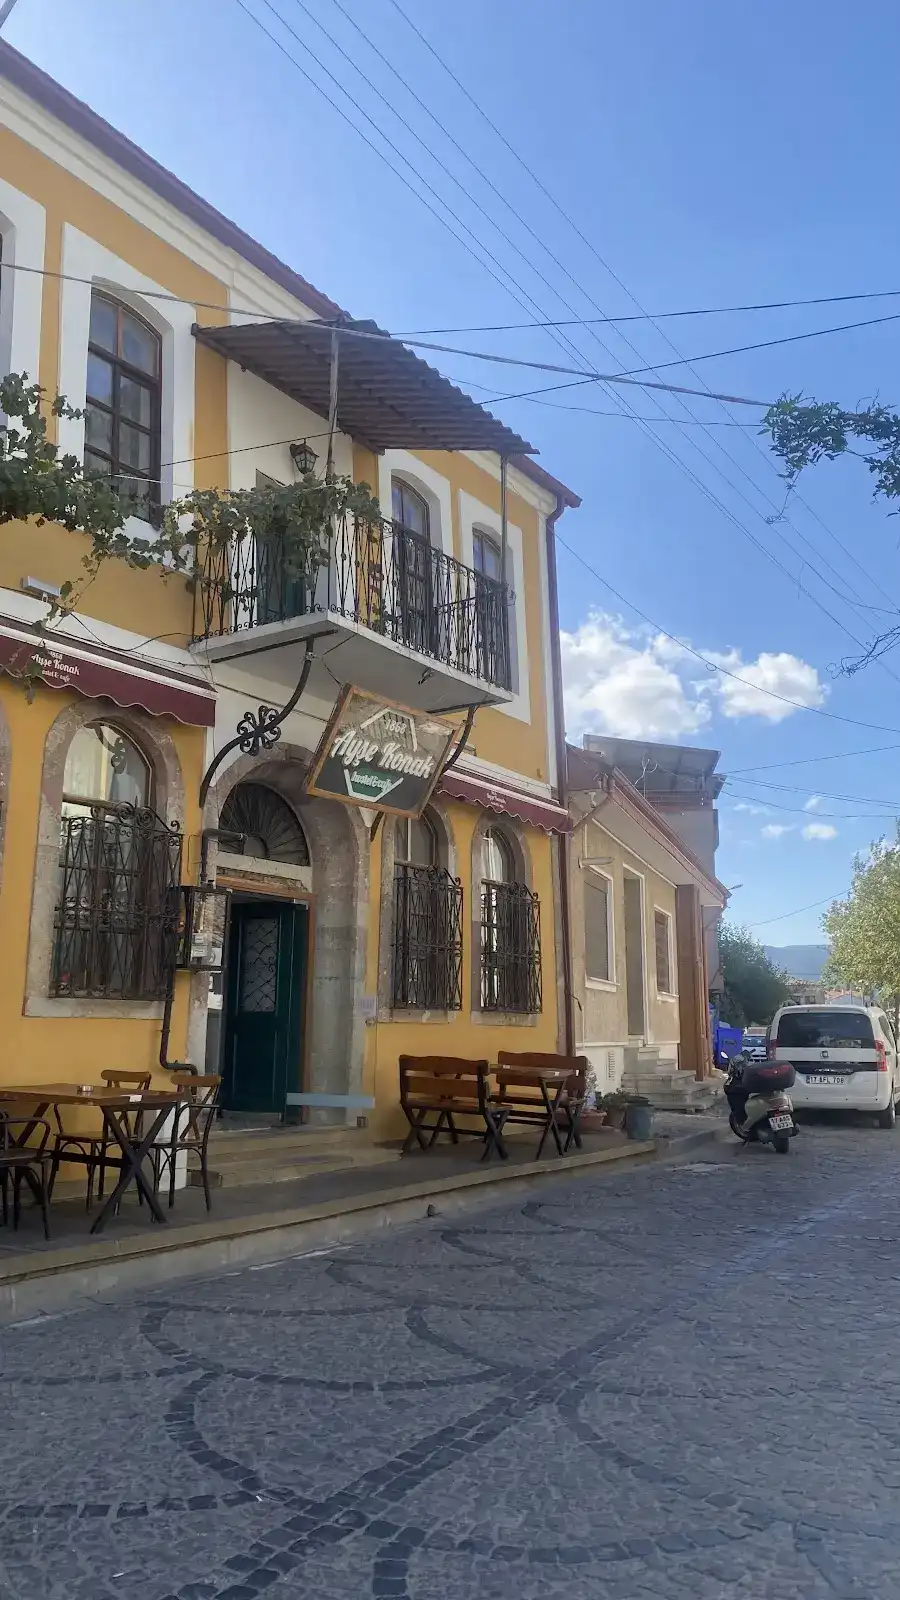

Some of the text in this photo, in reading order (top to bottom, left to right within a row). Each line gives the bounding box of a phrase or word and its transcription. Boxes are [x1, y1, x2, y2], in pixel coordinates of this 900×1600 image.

[53, 659, 80, 675] Konak
[384, 719, 407, 734] 1868
[330, 730, 435, 779] Ayşe Konak
